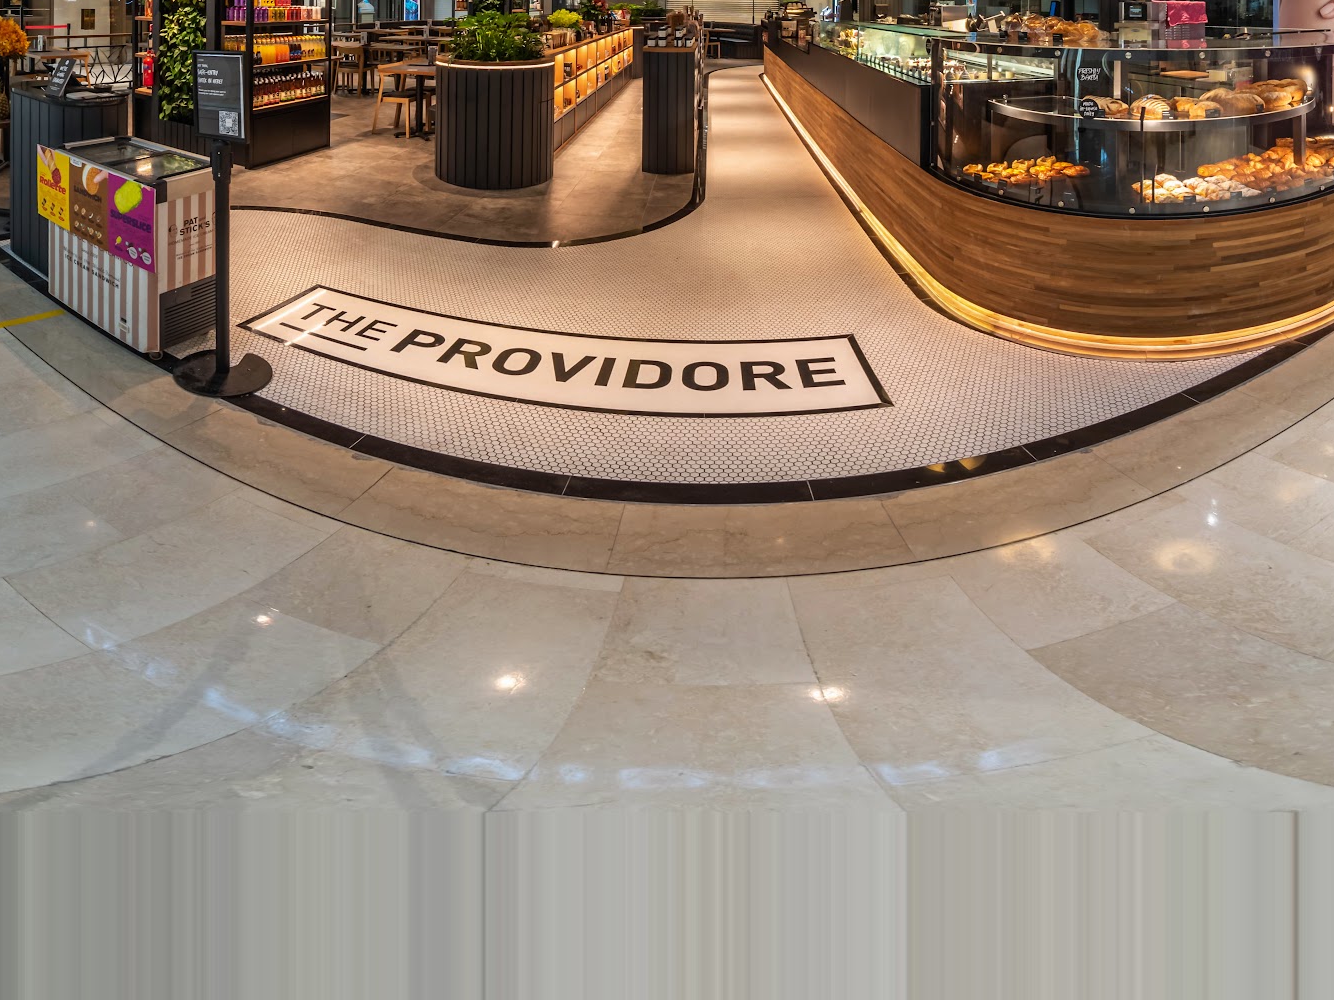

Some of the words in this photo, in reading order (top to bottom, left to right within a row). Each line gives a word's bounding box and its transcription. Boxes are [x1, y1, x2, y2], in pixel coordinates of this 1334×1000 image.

[39, 176, 66, 195] Rollette
[179, 220, 210, 236] STICK'S
[183, 216, 198, 227] PAT
[298, 302, 399, 342] THE
[390, 328, 847, 393] PROVIDORE
